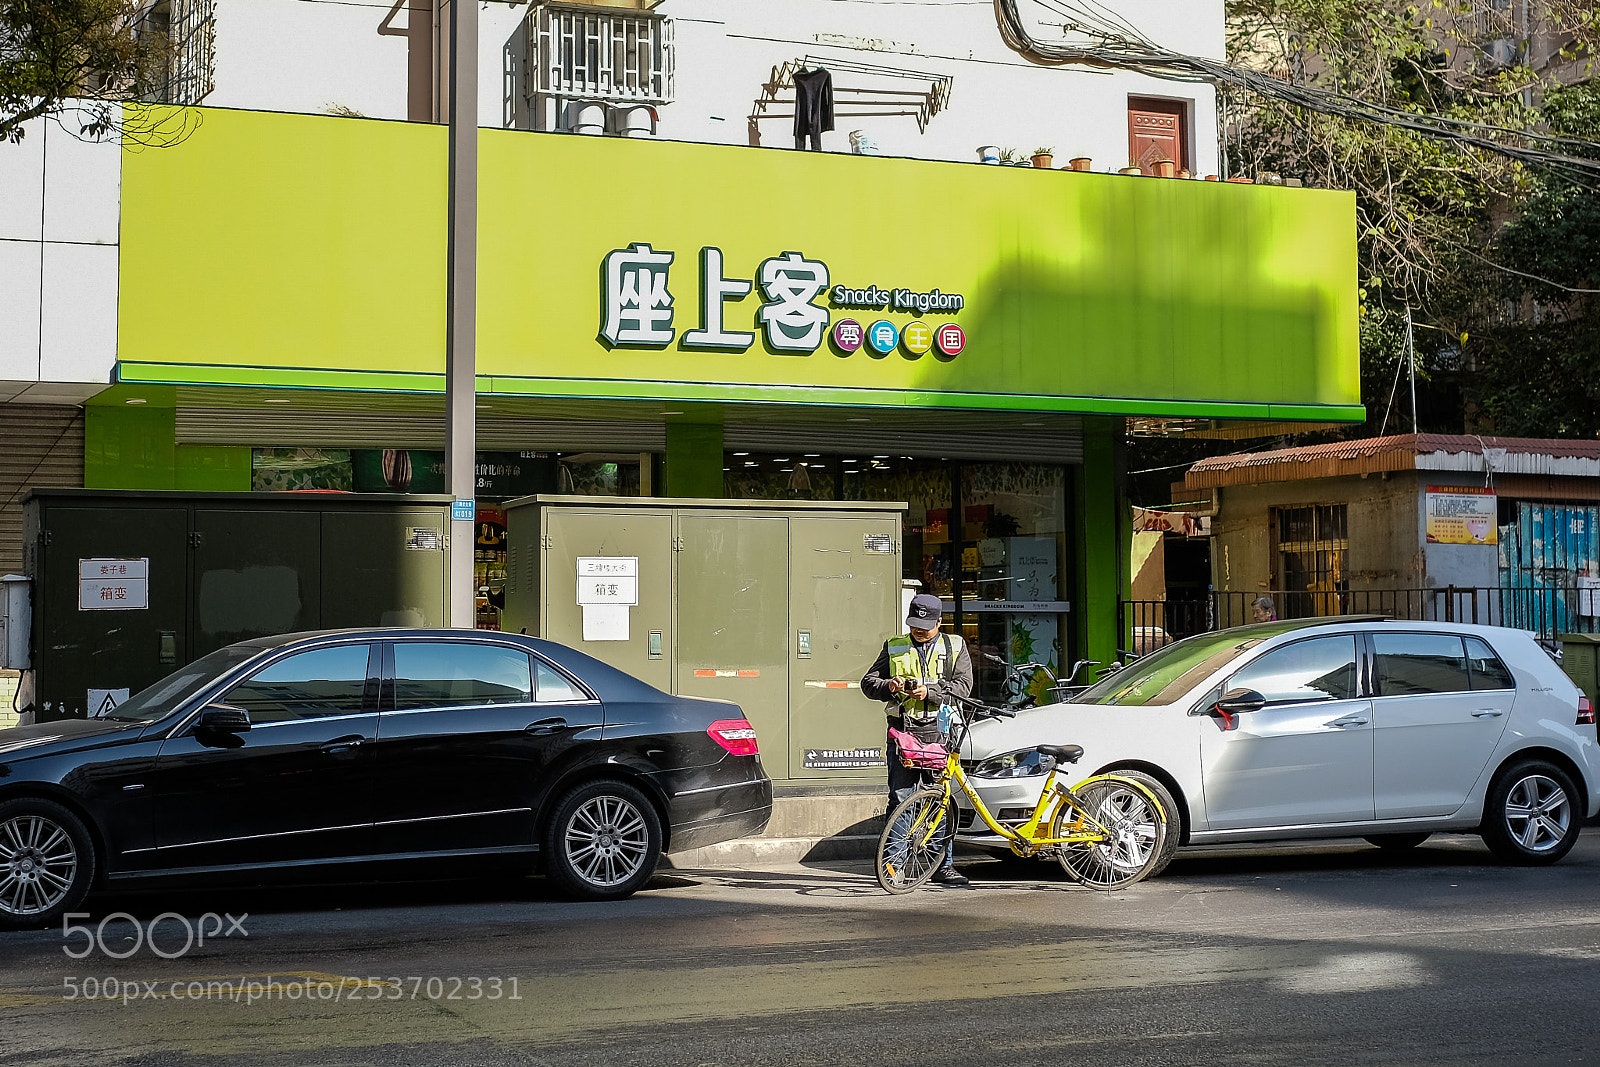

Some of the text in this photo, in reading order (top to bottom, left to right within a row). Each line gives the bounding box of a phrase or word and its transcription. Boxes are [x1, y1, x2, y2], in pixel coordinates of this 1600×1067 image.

[597, 243, 829, 352] 座上客
[833, 285, 965, 313] Snacks Kingdom
[834, 319, 966, 354] 零食王国
[100, 586, 127, 600] 箱变
